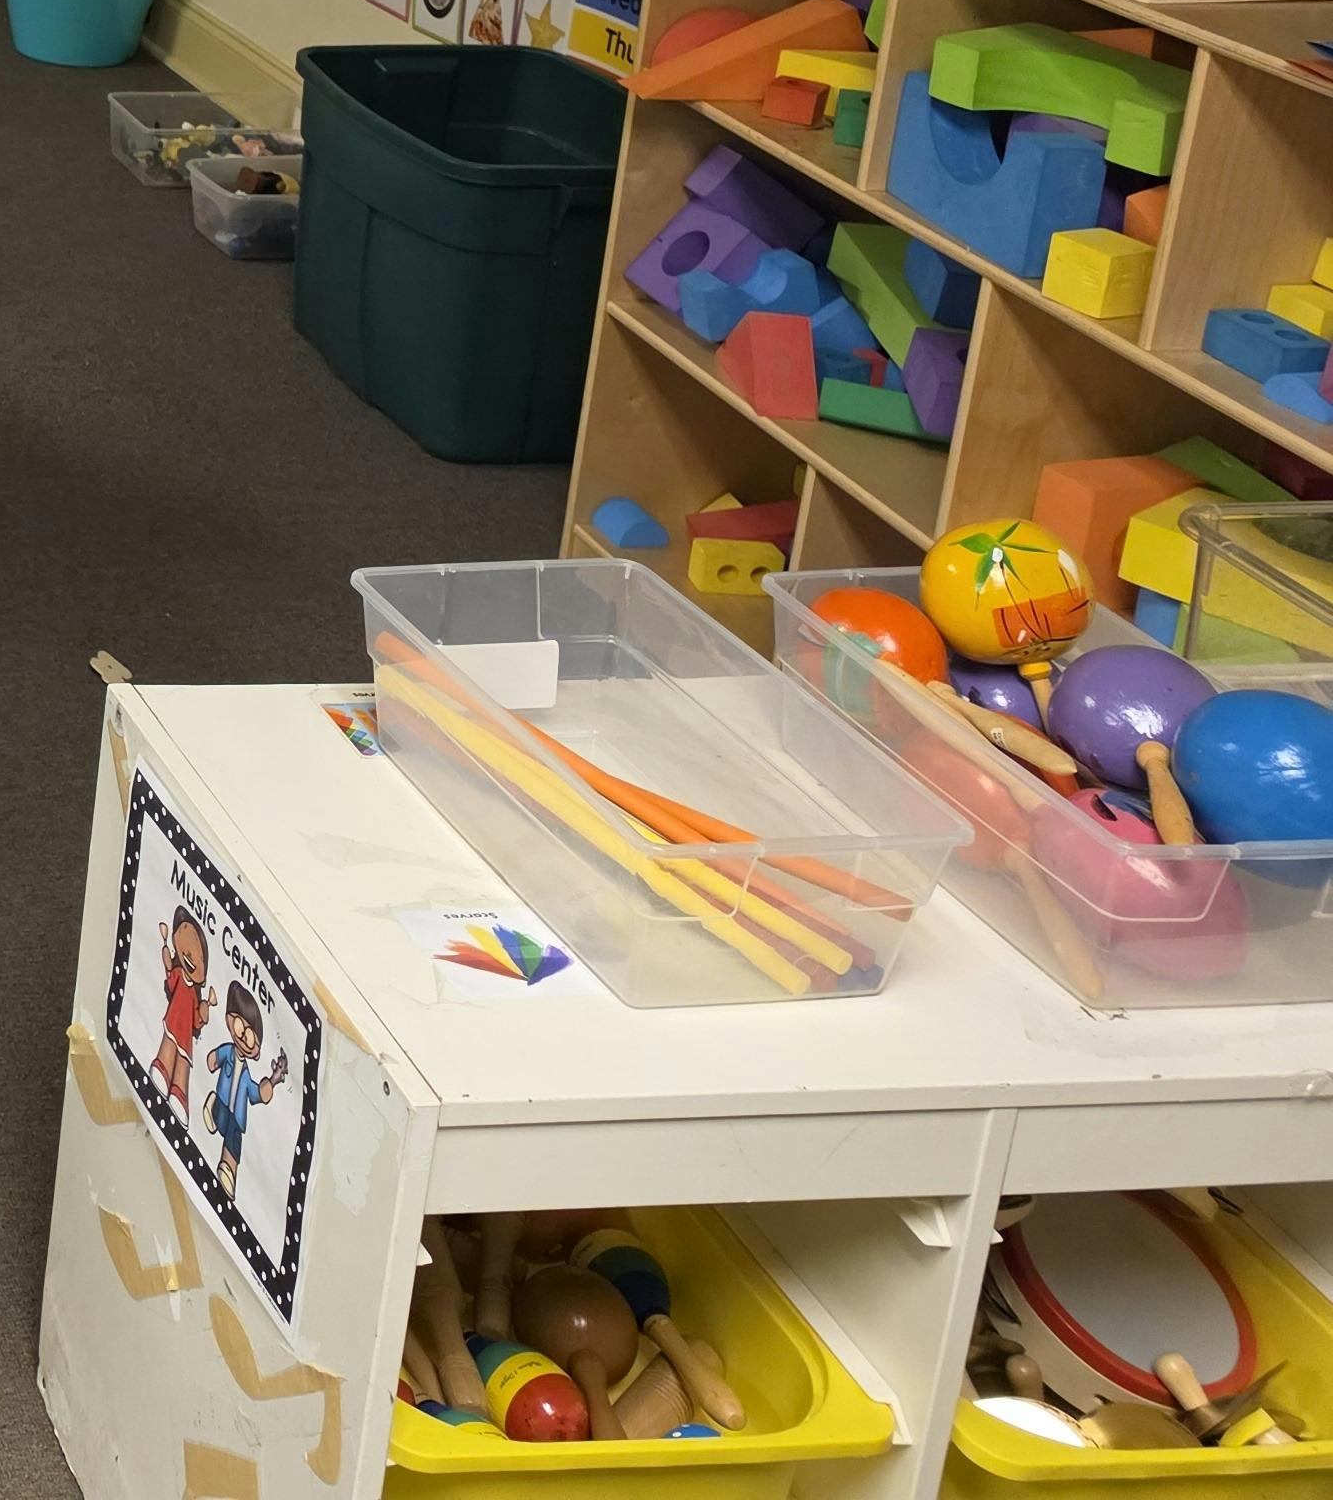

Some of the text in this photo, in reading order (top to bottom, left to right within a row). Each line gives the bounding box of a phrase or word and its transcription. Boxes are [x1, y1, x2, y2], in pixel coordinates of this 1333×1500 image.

[170, 858, 276, 1014] Music Center
[442, 911, 499, 920] Scarves
